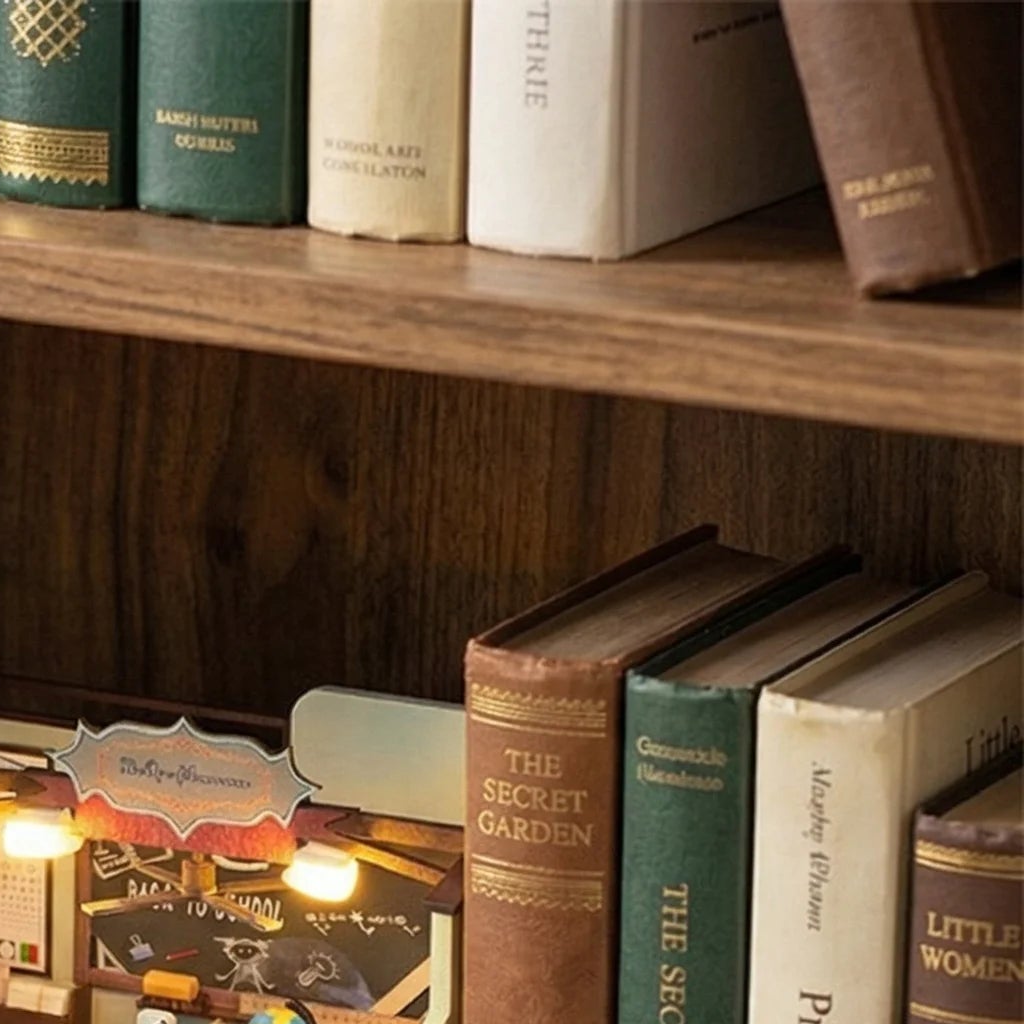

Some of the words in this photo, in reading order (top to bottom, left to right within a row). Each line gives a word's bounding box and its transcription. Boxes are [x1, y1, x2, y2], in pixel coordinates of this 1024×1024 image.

[504, 748, 562, 778] THE
[483, 777, 588, 814] SECRET
[478, 809, 594, 847] GARDEN
[661, 883, 689, 952] THE
[927, 910, 1021, 949] LITTLE
[919, 943, 1024, 982] WOMEN
